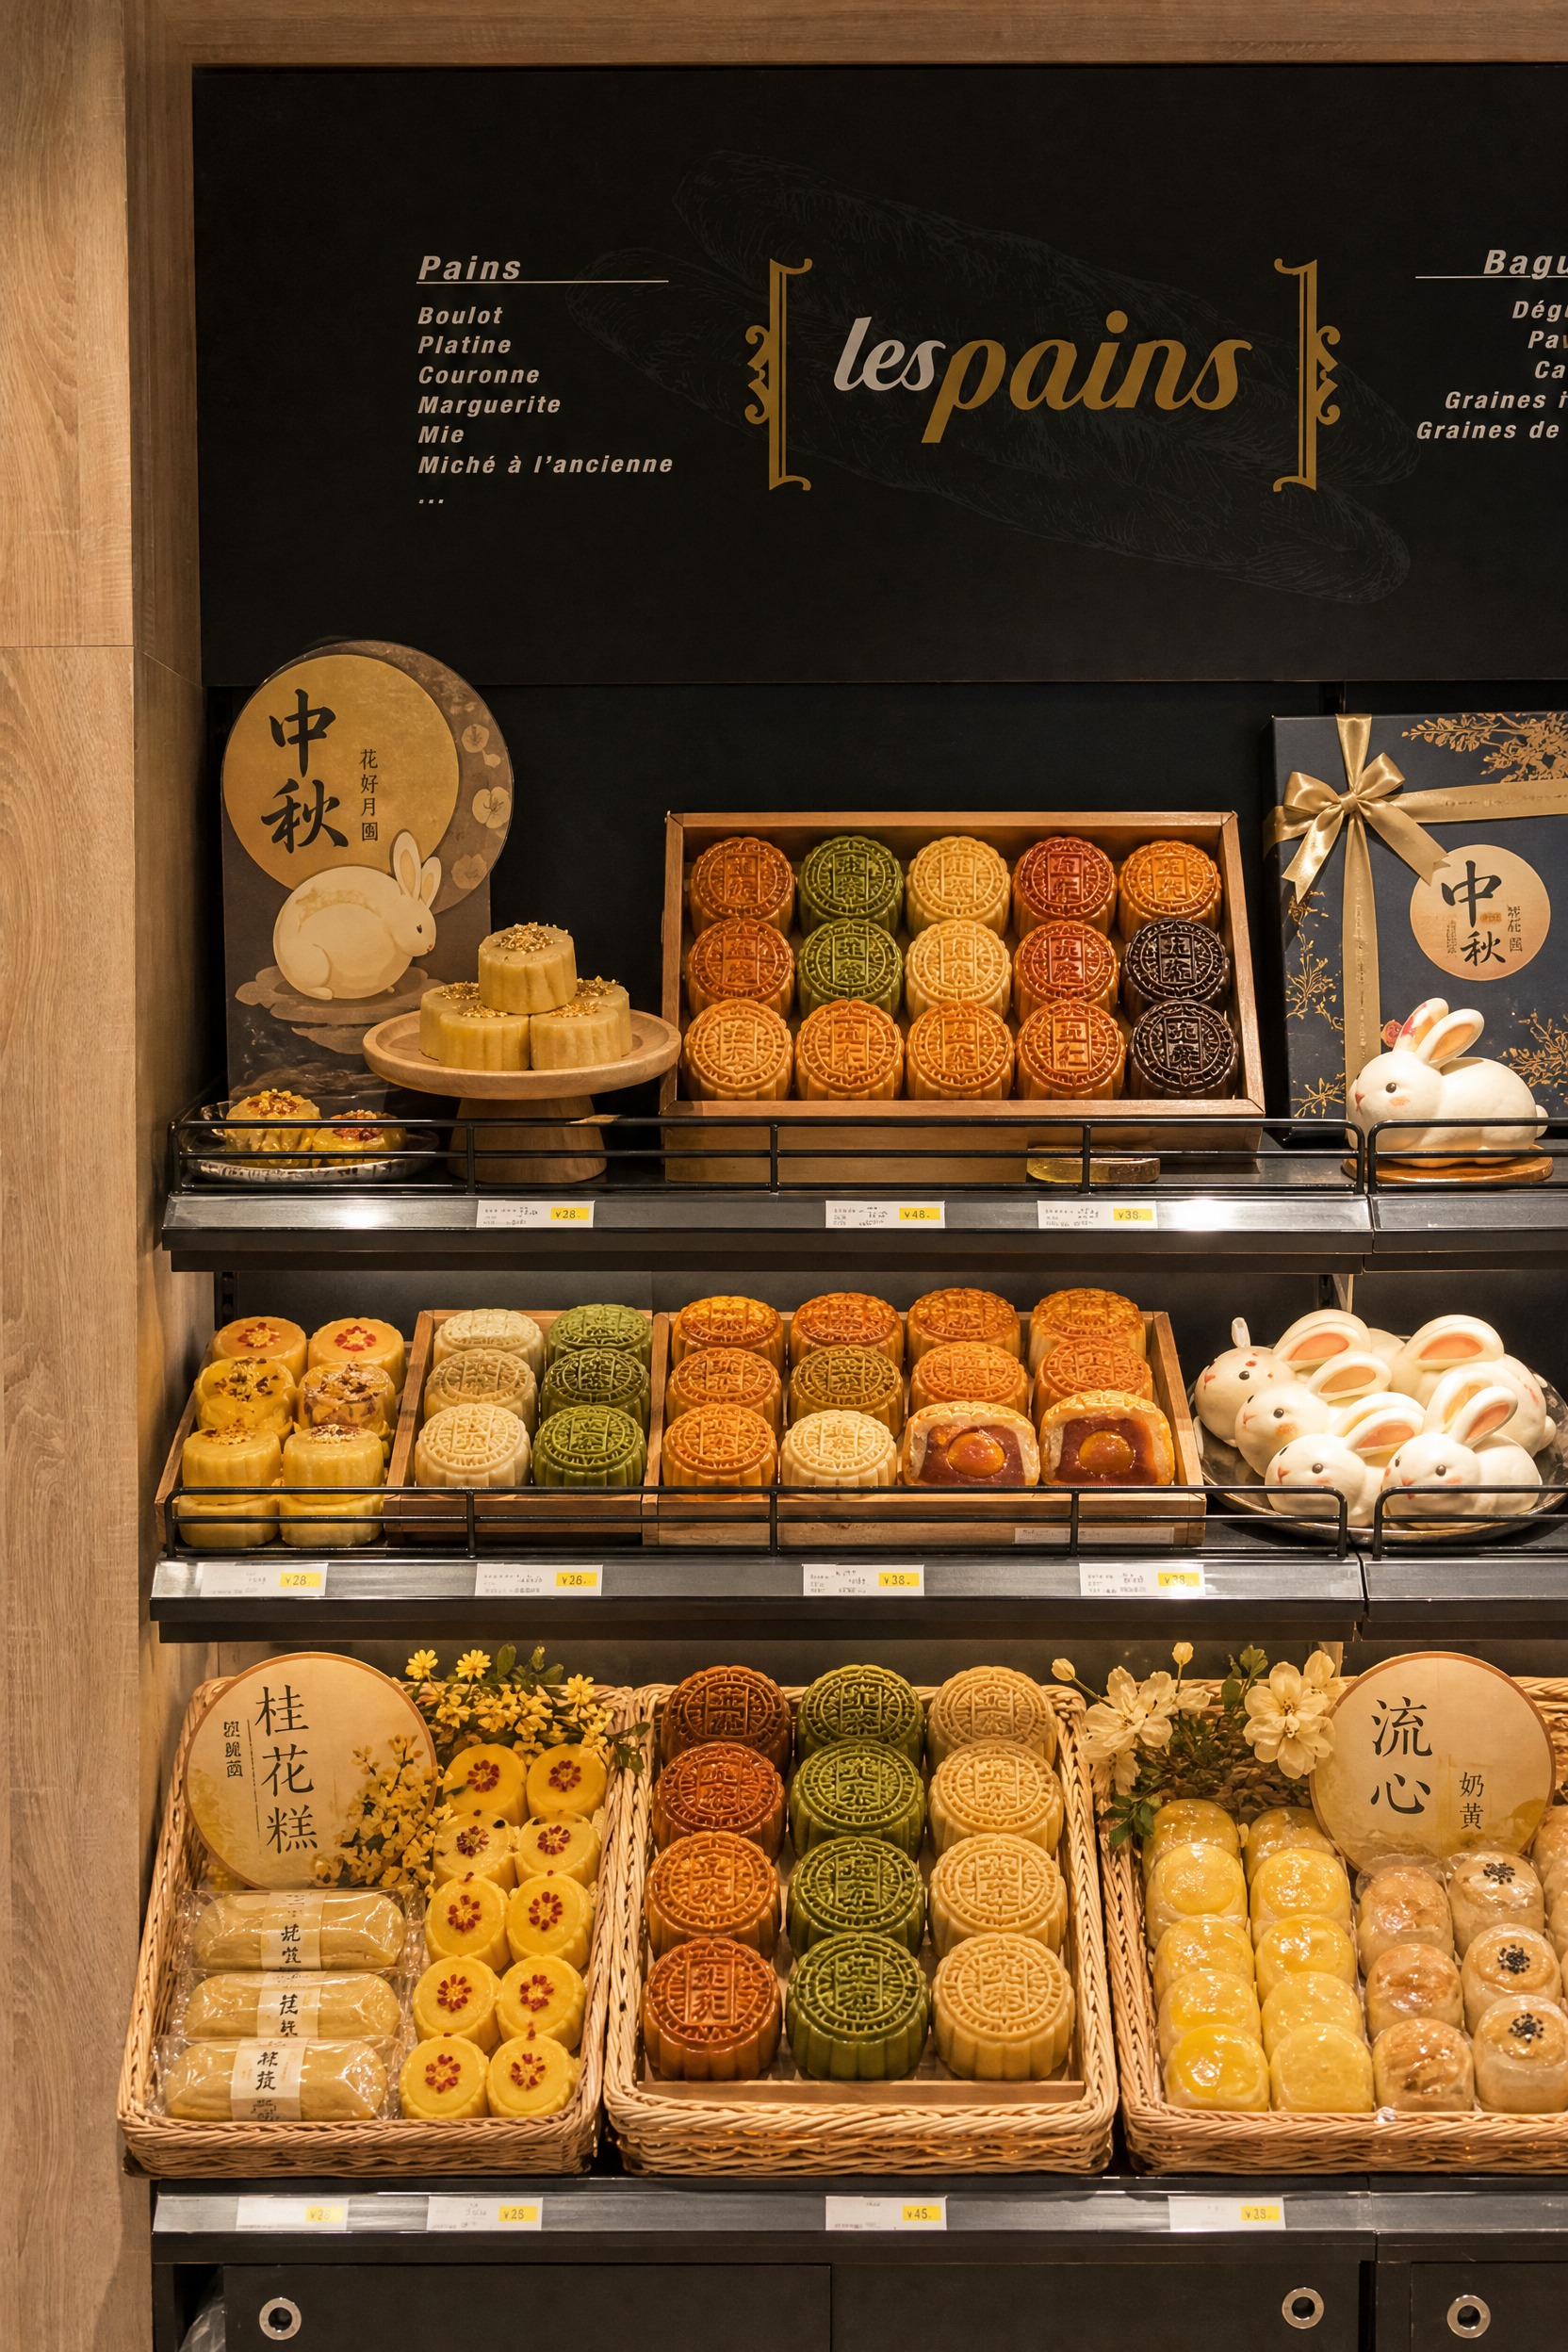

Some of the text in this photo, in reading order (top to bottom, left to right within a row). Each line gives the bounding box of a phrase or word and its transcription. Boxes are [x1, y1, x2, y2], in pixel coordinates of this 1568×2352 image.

[418, 255, 521, 280] Pains
[417, 306, 503, 324] Boulot
[1512, 300, 1568, 322] Dég
[417, 335, 512, 353] Platine
[418, 366, 540, 384] Couronne
[834, 310, 1253, 444] les pains
[417, 396, 561, 417] Marguerite
[1445, 391, 1546, 409] Graines
[417, 426, 465, 443] Mie
[1416, 421, 1560, 439] Graines de
[417, 455, 673, 474] Miché à l’ancienne
[261, 688, 350, 854] 中秋
[1441, 859, 1507, 967] 中秋
[1370, 1695, 1433, 1815] 流心
[254, 1684, 318, 1855] 桂花糕
[1458, 1772, 1485, 1831] 奶黄
